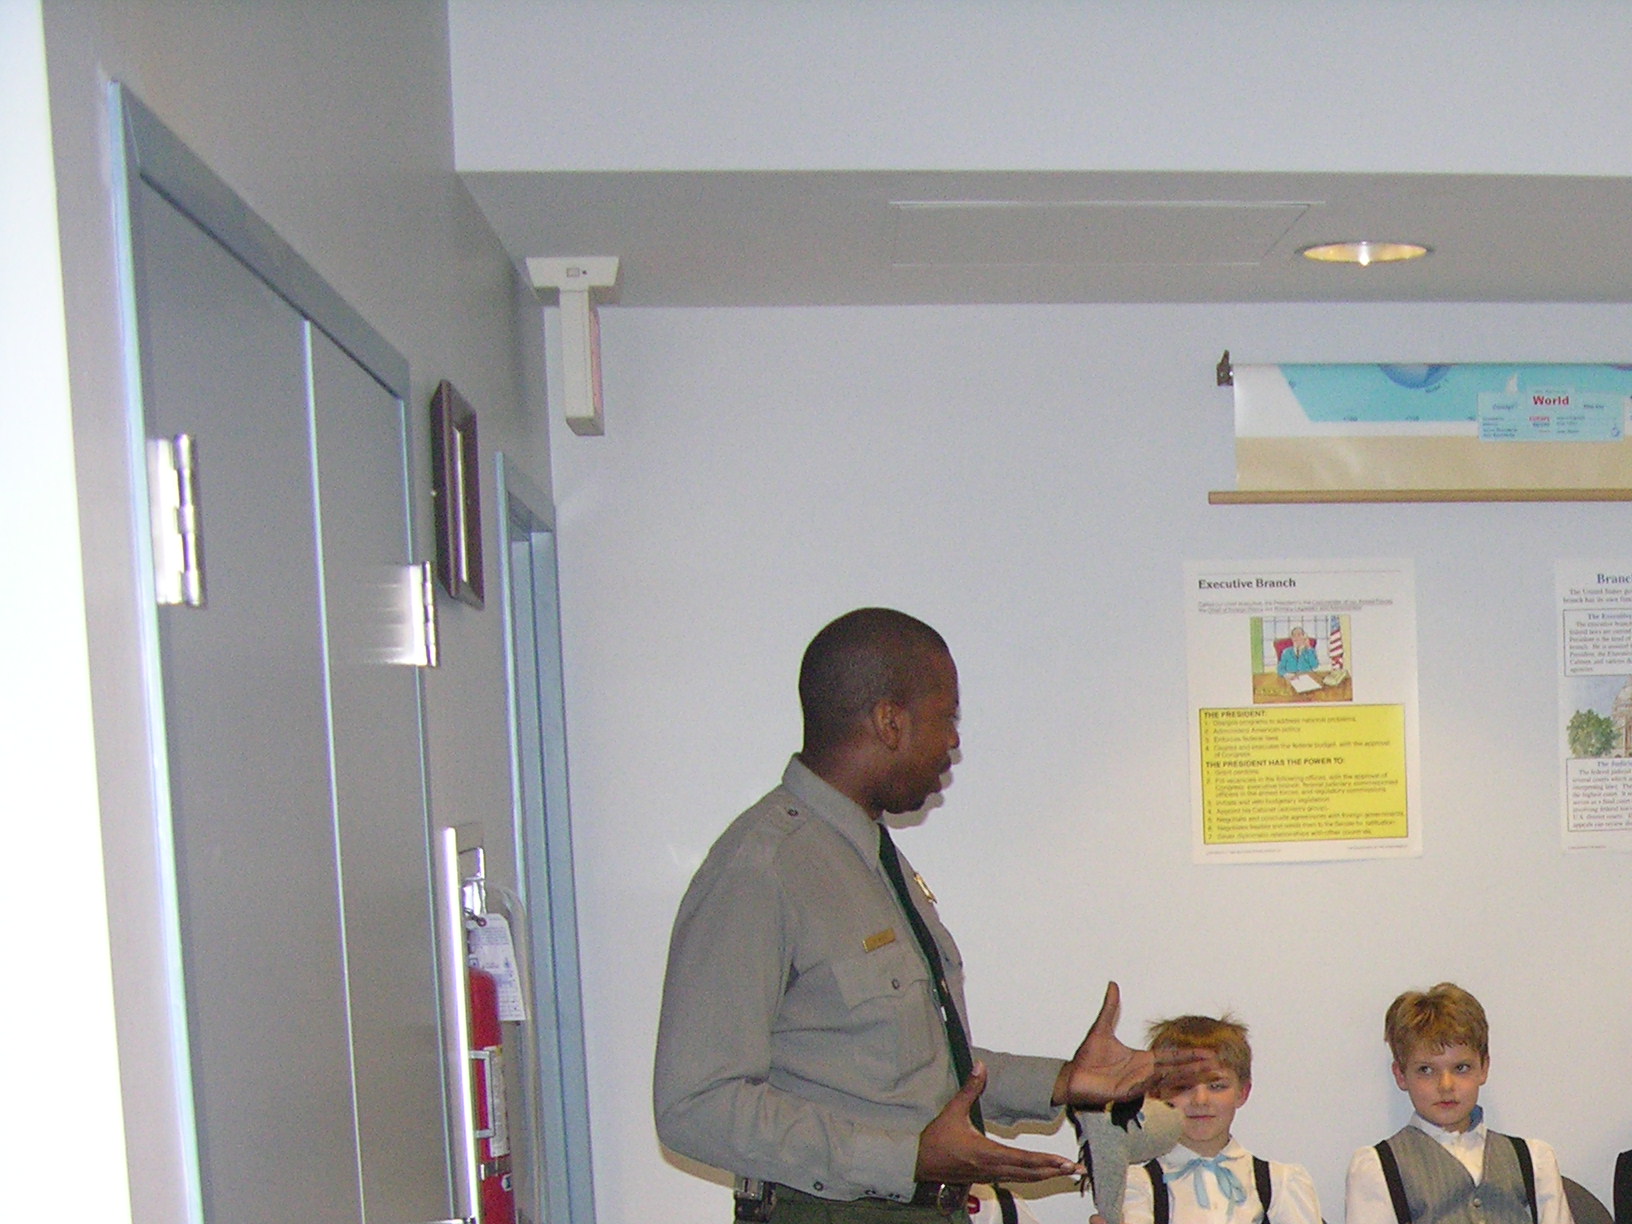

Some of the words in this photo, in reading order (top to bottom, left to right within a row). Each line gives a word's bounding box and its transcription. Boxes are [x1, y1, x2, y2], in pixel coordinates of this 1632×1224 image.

[1532, 395, 1570, 406] World
[1198, 578, 1253, 590] Executive
[1255, 577, 1297, 588] Branch
[1204, 711, 1218, 719] THE
[1223, 759, 1267, 768] PRESIDENT
[1268, 758, 1285, 766] HAS
[1303, 757, 1332, 765] POWER
